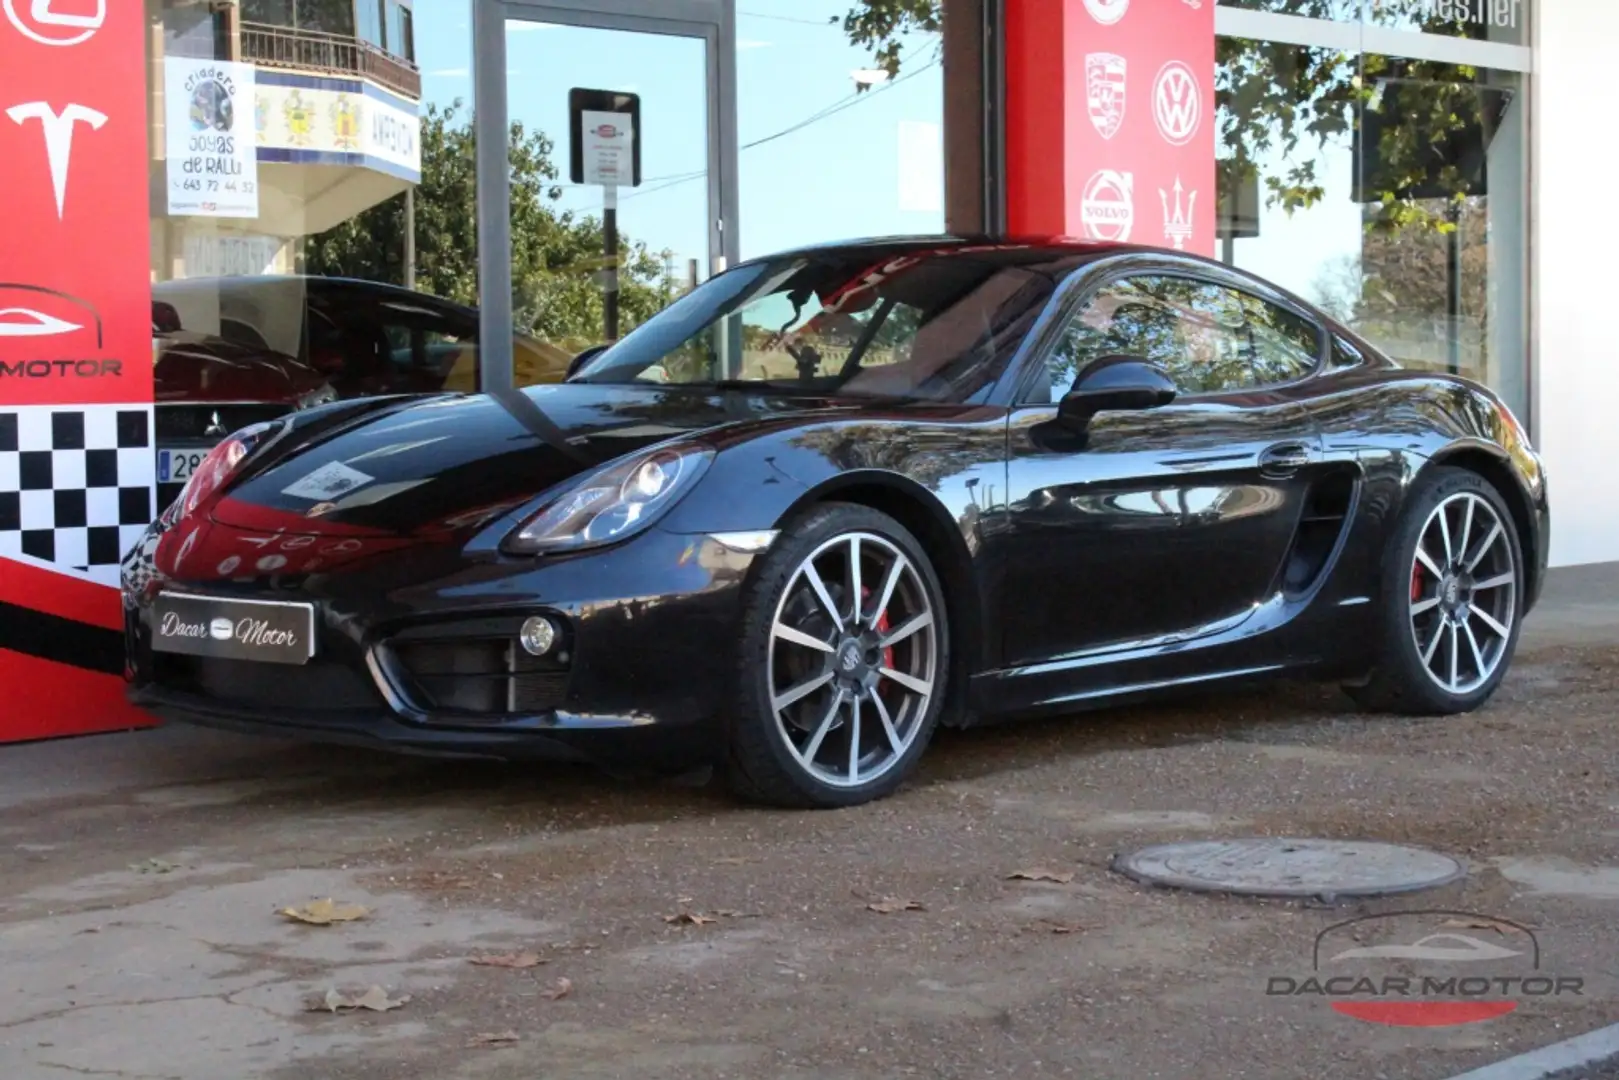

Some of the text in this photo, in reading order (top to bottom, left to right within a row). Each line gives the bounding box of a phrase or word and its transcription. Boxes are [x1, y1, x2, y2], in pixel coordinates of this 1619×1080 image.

[183, 156, 202, 174] de
[1085, 206, 1129, 219] VOLVO
[0, 359, 122, 378] MOTOR
[174, 453, 207, 478] 28
[160, 611, 297, 647] Dacar Motor
